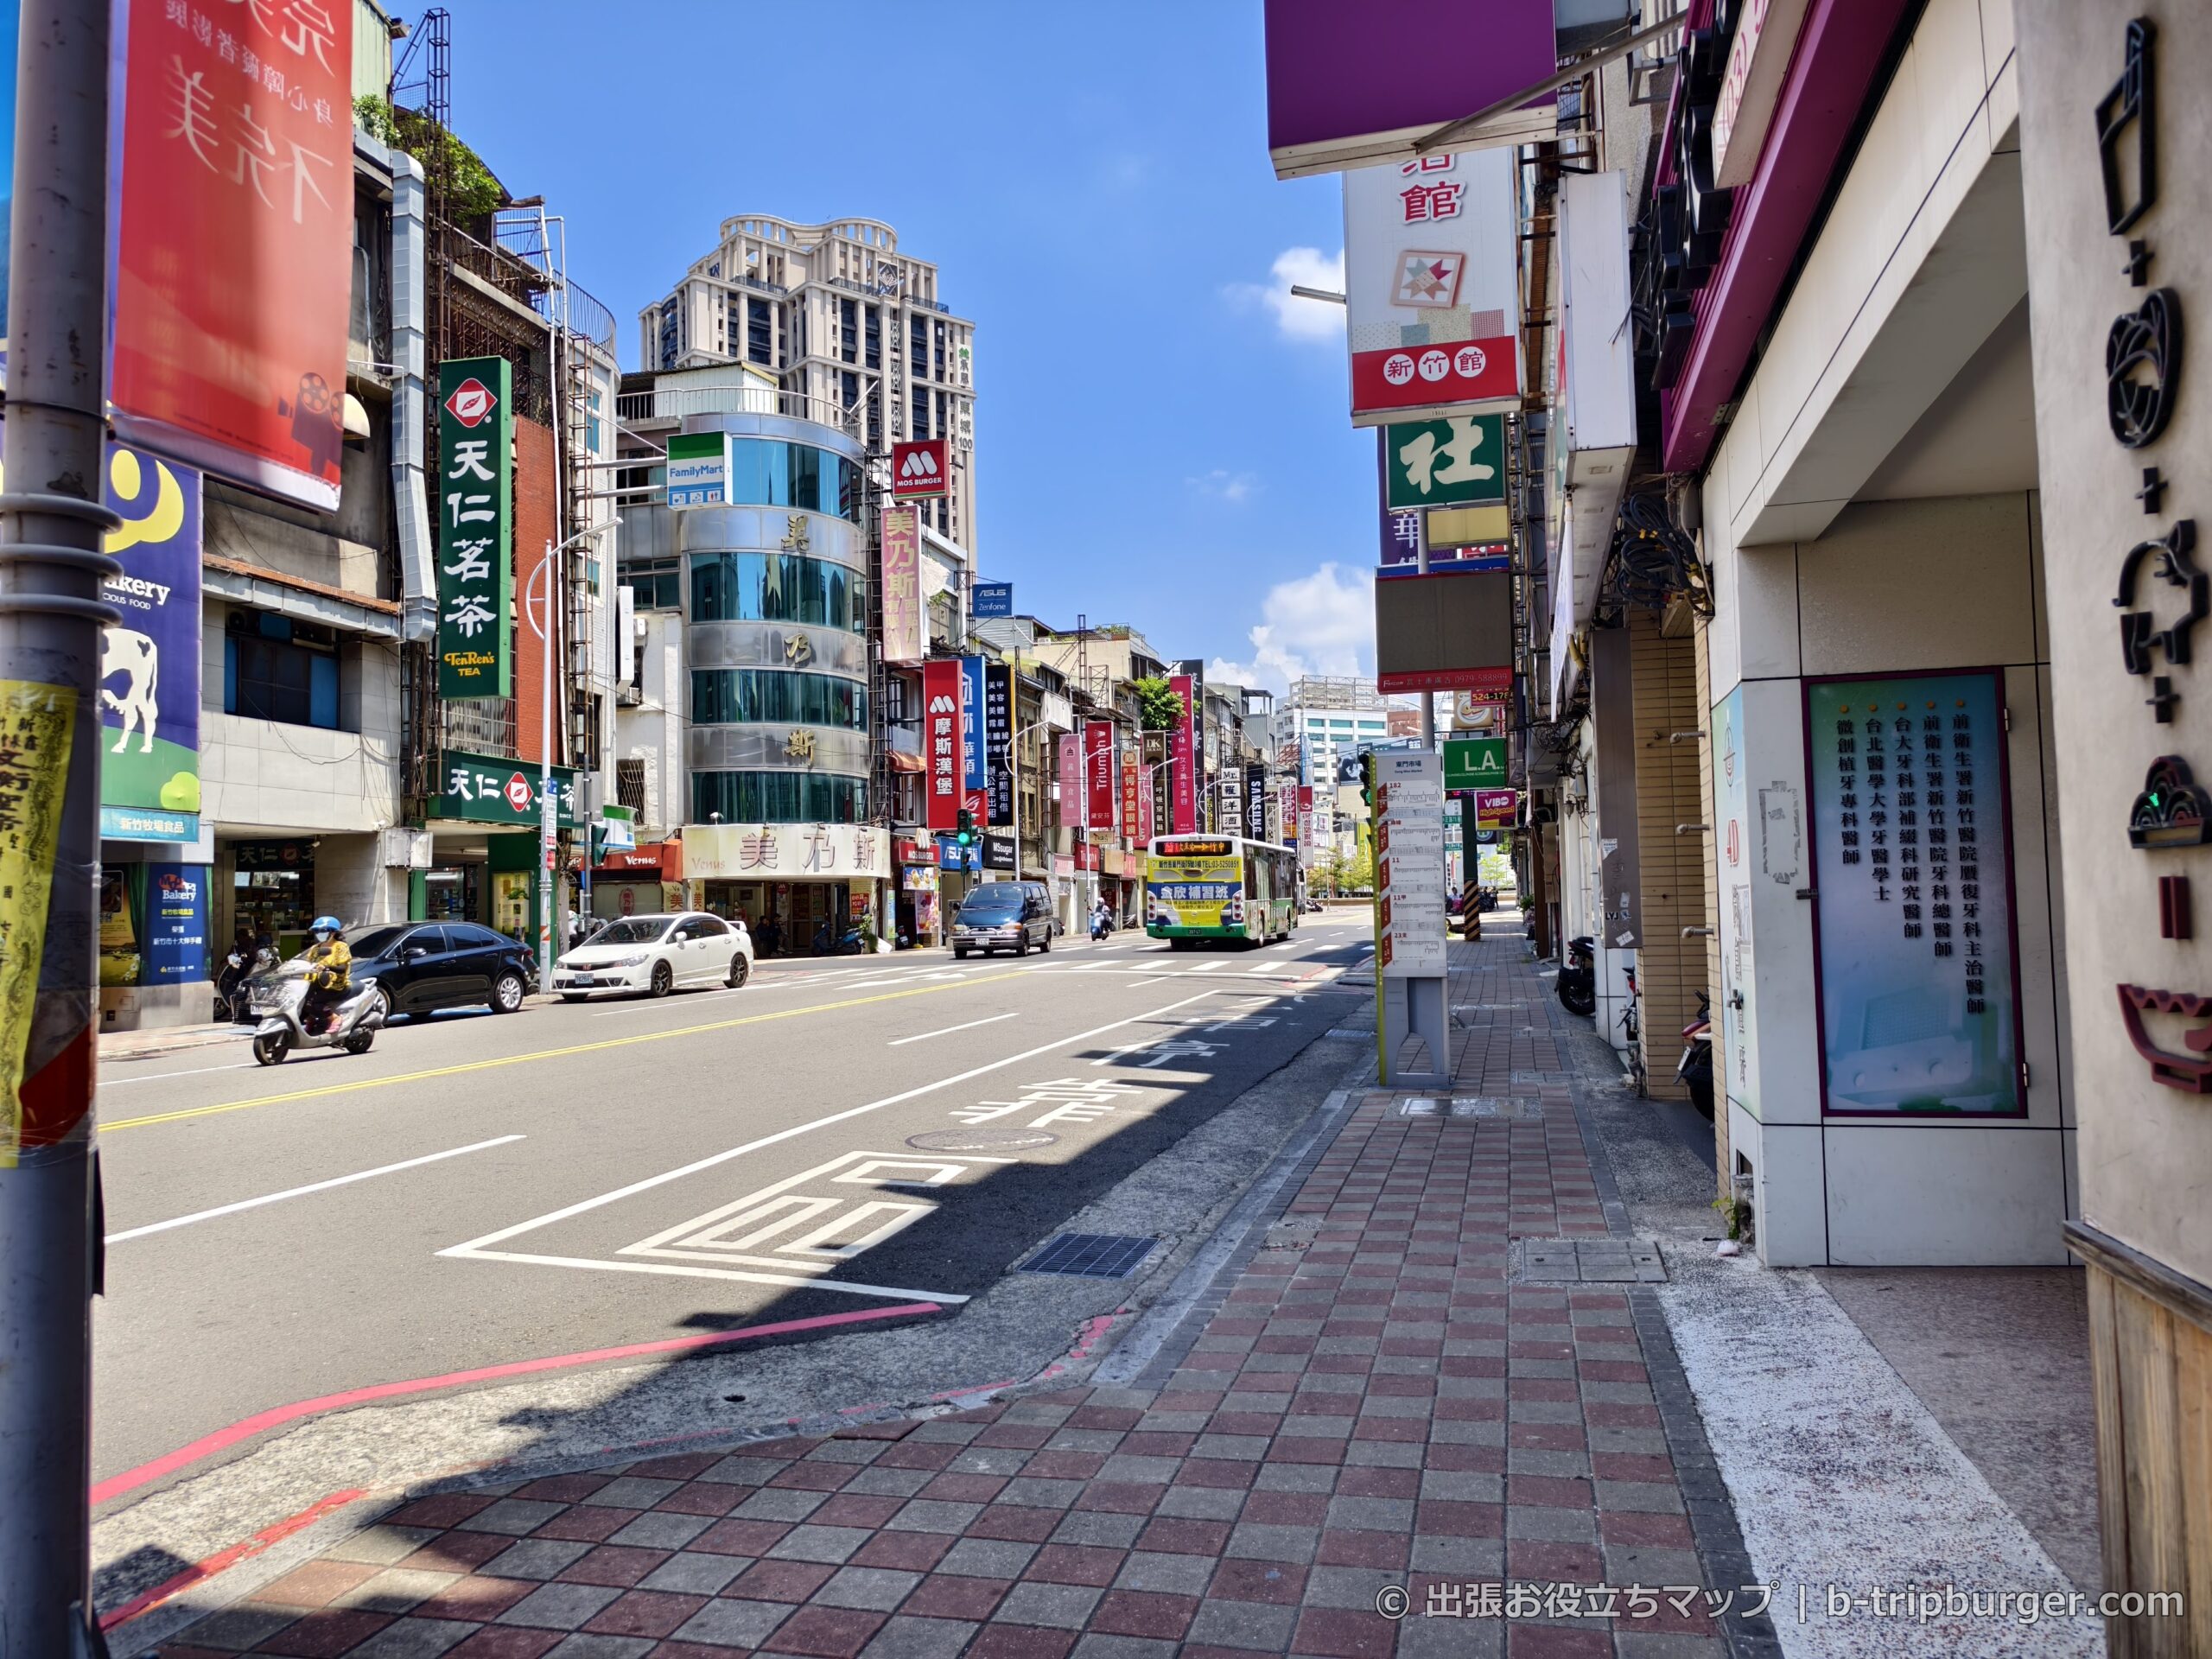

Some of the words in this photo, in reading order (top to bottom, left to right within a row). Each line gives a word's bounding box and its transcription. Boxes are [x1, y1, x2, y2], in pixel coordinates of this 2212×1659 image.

[1387, 351, 1483, 378] 新竹館
[670, 463, 724, 479] FamilyMart
[914, 477, 942, 486] BURGER
[444, 440, 498, 639] 天仁茗茶
[886, 510, 915, 598] 美乃斯
[105, 572, 170, 605] akery
[978, 602, 1007, 611] Zenfone
[458, 668, 480, 677] TEA
[935, 717, 953, 796] 摩斯漢堡
[448, 768, 500, 801] 天仁
[1836, 719, 1861, 866] 微創植牙專科醫師
[1251, 781, 1262, 832] SAMSUNG
[1865, 718, 1891, 902] 台北醫學大學牙醫學士
[120, 817, 185, 834] 新竹牧場食品
[1894, 716, 1923, 940] 台大牙科部補綴科研究醫師
[625, 855, 657, 866] Venus
[692, 857, 725, 871] Venus
[740, 832, 875, 870] 美乃斯
[162, 890, 197, 901] Bakery
